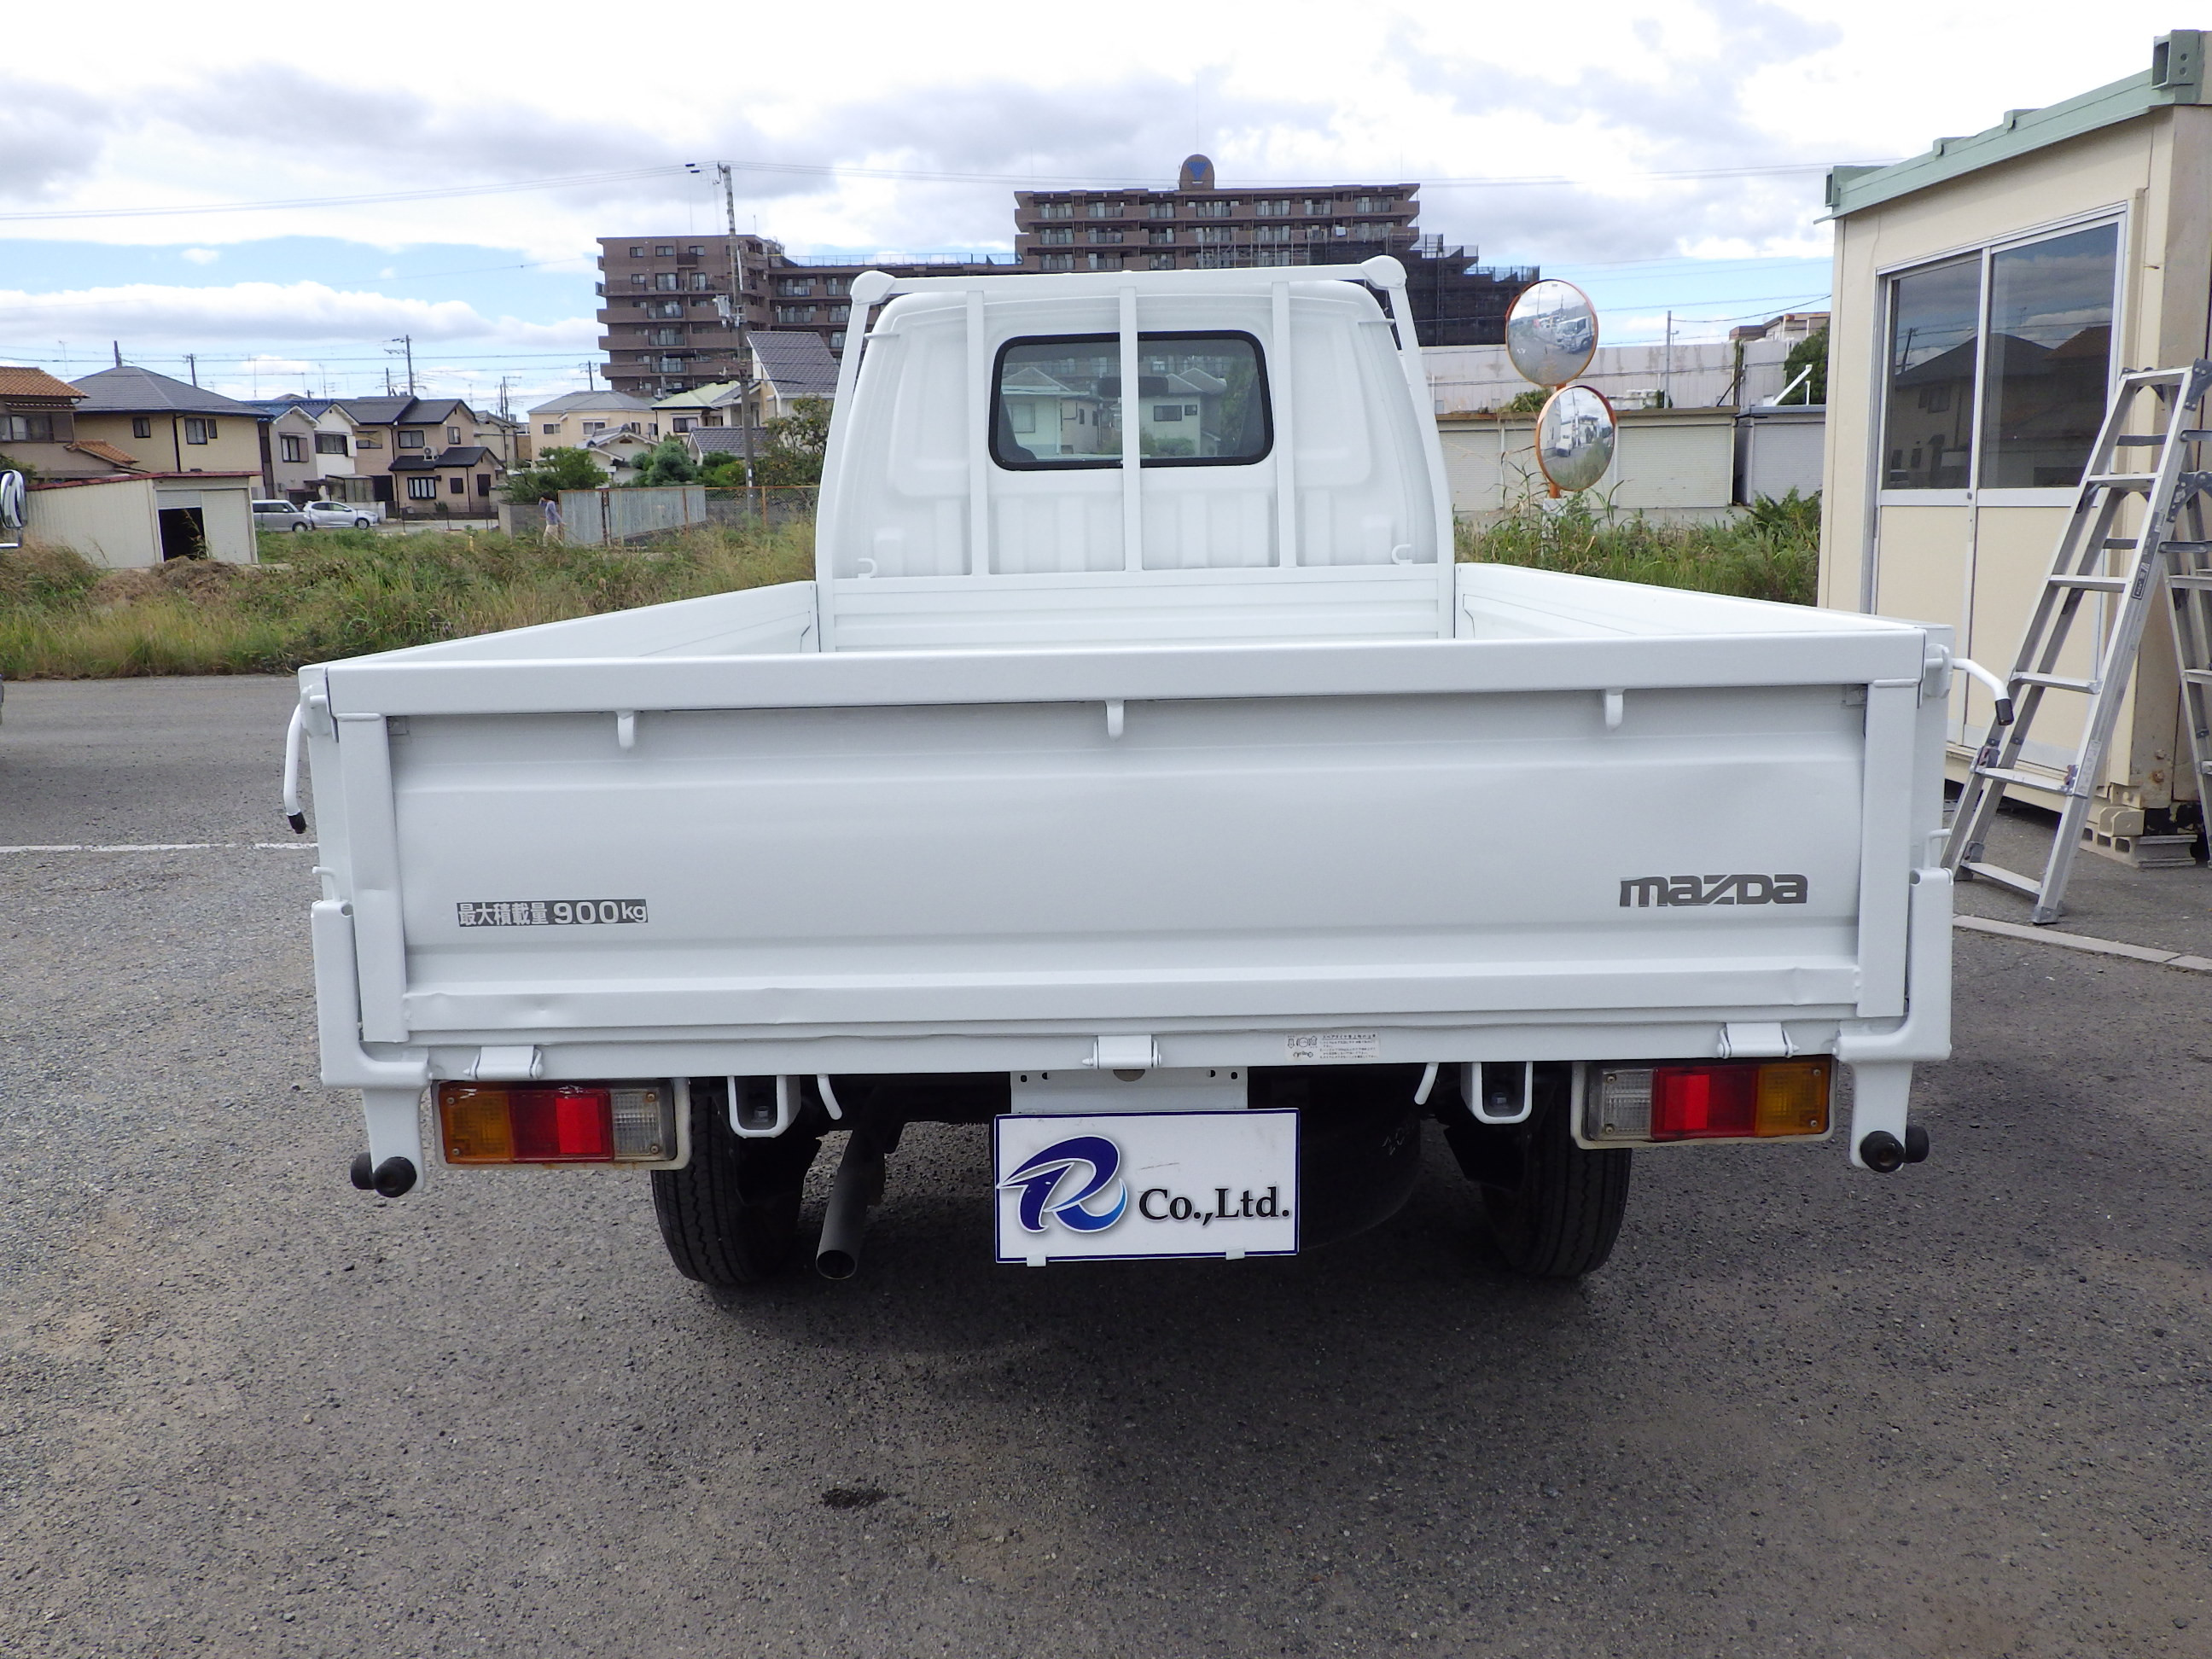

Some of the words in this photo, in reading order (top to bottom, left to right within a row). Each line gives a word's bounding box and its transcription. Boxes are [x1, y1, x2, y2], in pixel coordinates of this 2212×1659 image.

[458, 902, 548, 926] 最大積載量
[553, 900, 647, 924] 900kg
[1138, 1186, 1290, 1226] Co.,Ltd.
